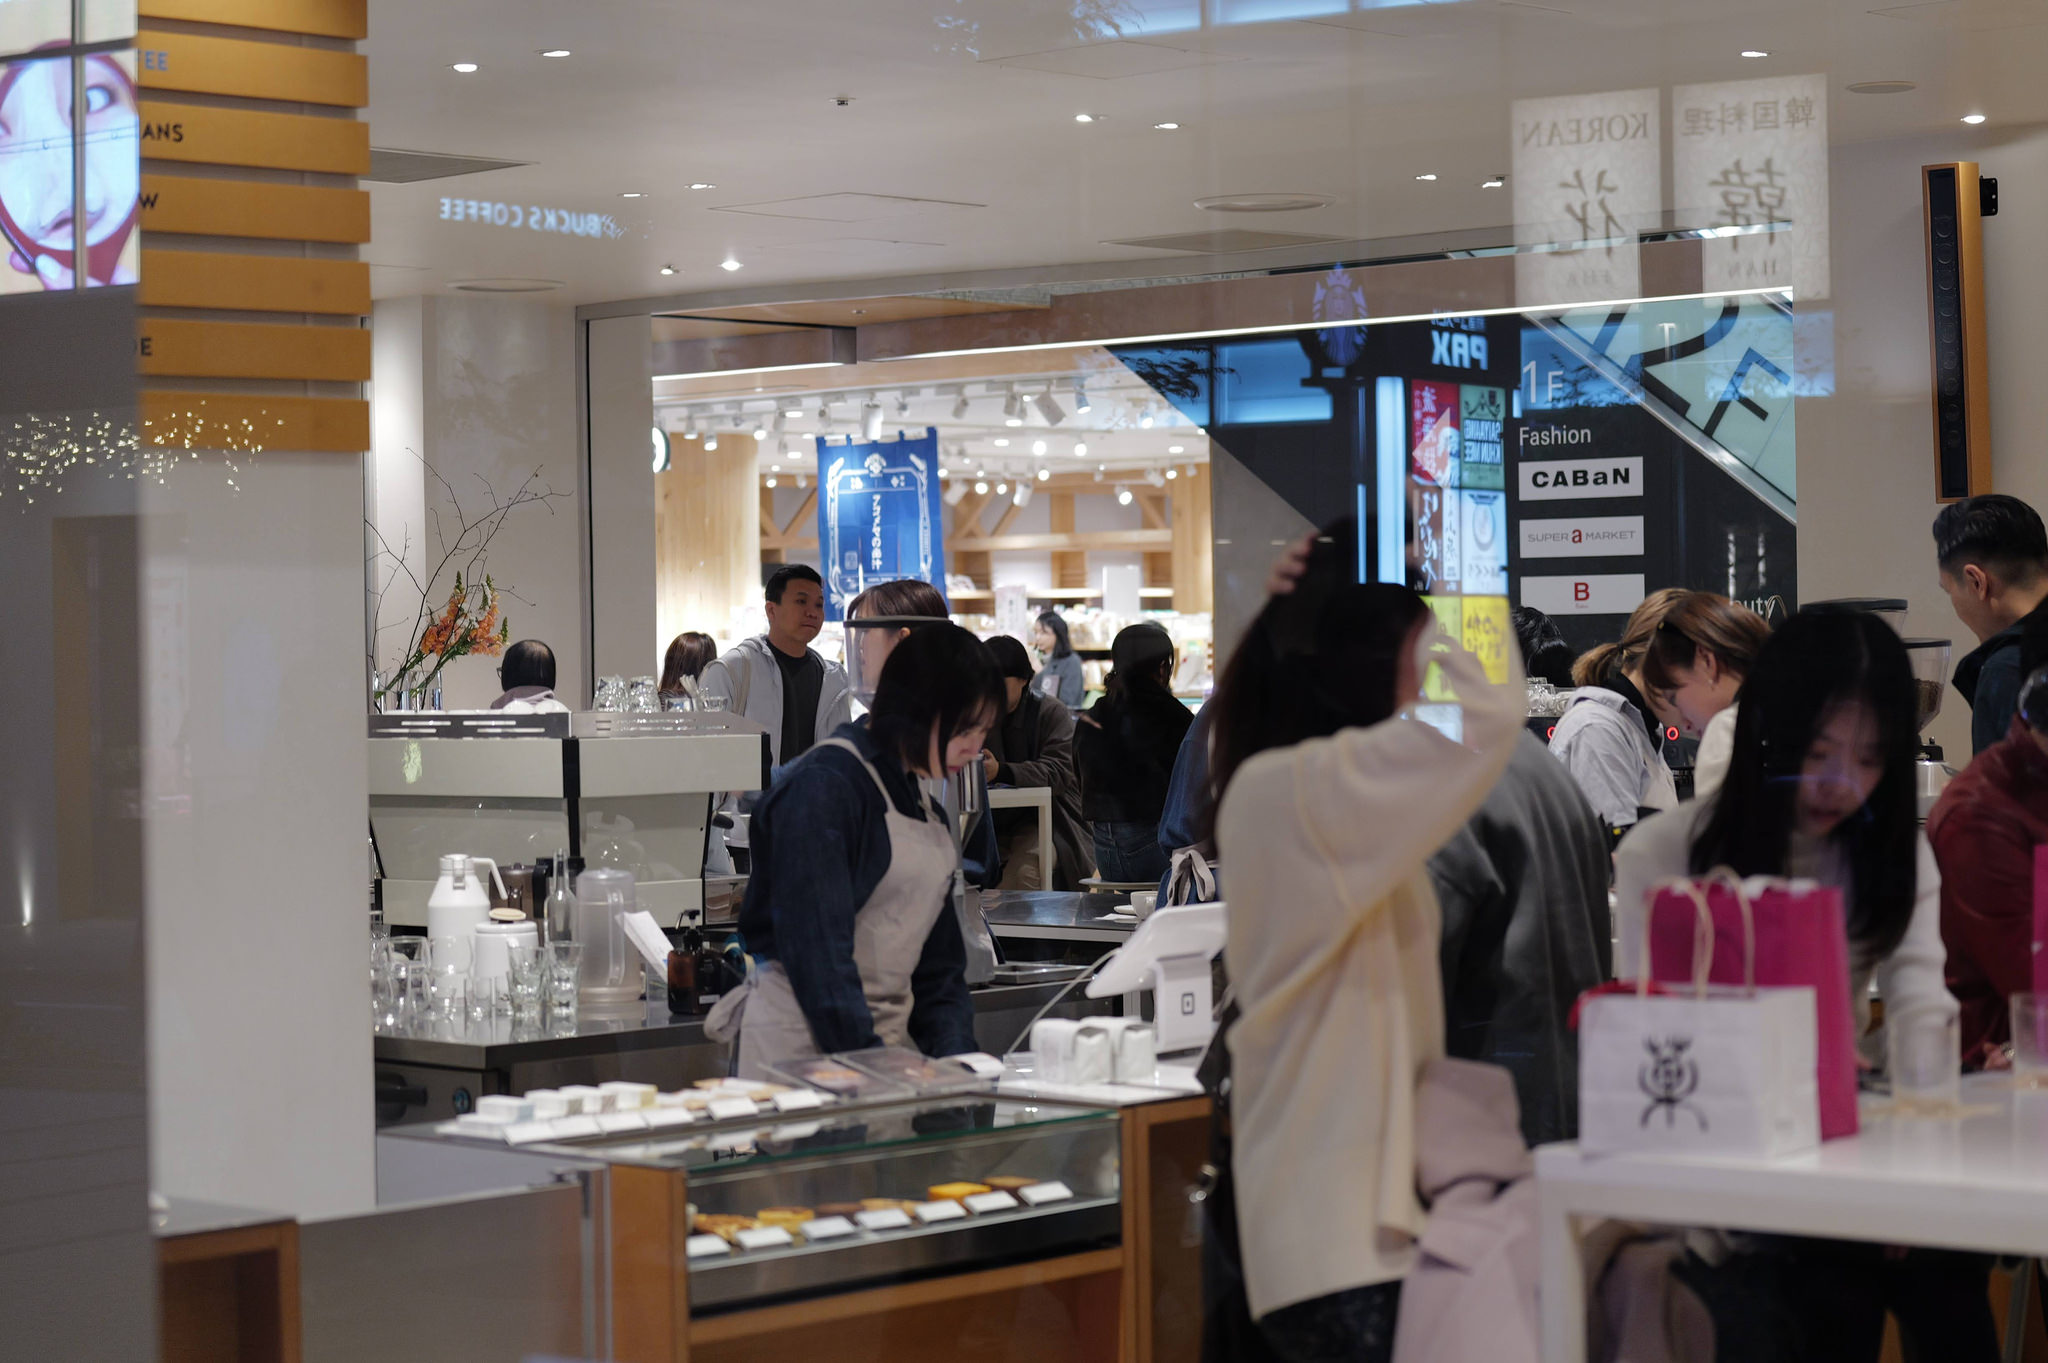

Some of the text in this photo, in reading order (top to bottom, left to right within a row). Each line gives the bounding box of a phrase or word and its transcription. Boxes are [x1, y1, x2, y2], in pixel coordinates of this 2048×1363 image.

[140, 50, 169, 71] EE
[142, 122, 184, 143] ANS
[1520, 424, 1591, 446] Fashion
[1531, 467, 1630, 489] CABaN
[1527, 528, 1637, 544] SUPER a MARKET
[1574, 582, 1590, 601] B
